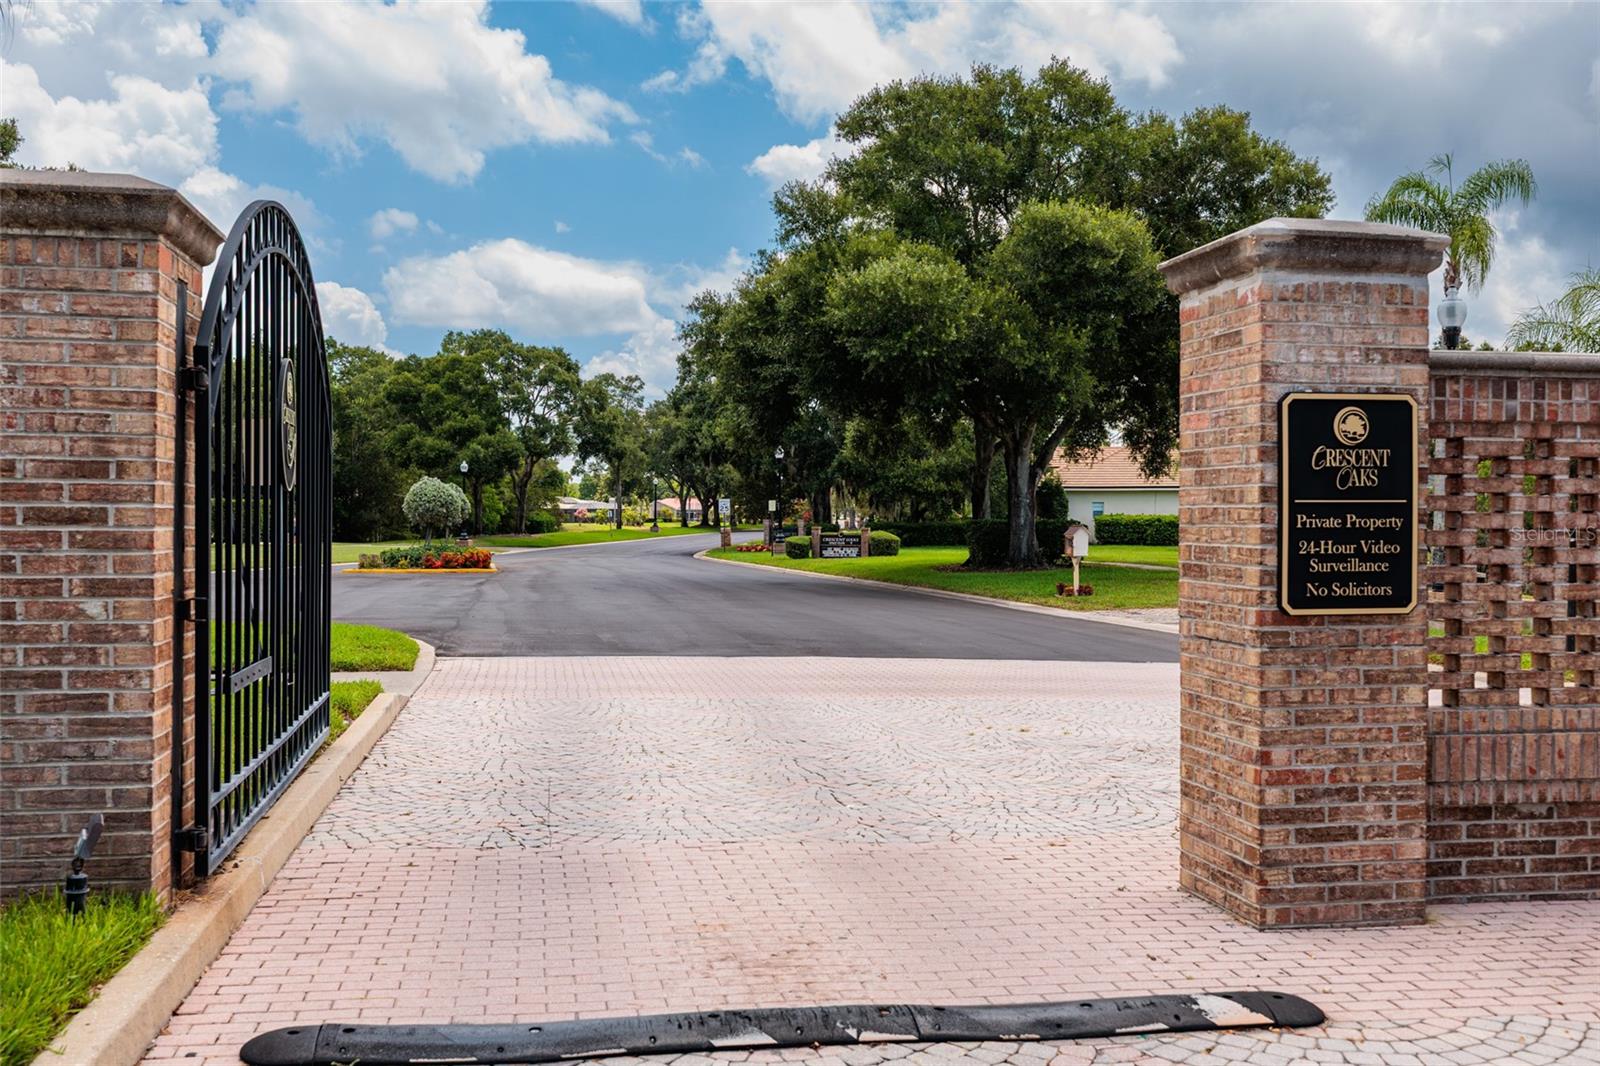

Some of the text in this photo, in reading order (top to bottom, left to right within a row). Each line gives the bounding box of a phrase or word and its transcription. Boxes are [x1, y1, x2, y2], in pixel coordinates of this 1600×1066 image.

[1311, 445, 1390, 470] CRESCENT
[1336, 466, 1378, 490] OAKS
[1296, 514, 1403, 531] Private Property
[1299, 540, 1400, 554] 24-Hour Video
[1309, 558, 1389, 573] Surveillance
[1306, 582, 1393, 597] No Solicitors
